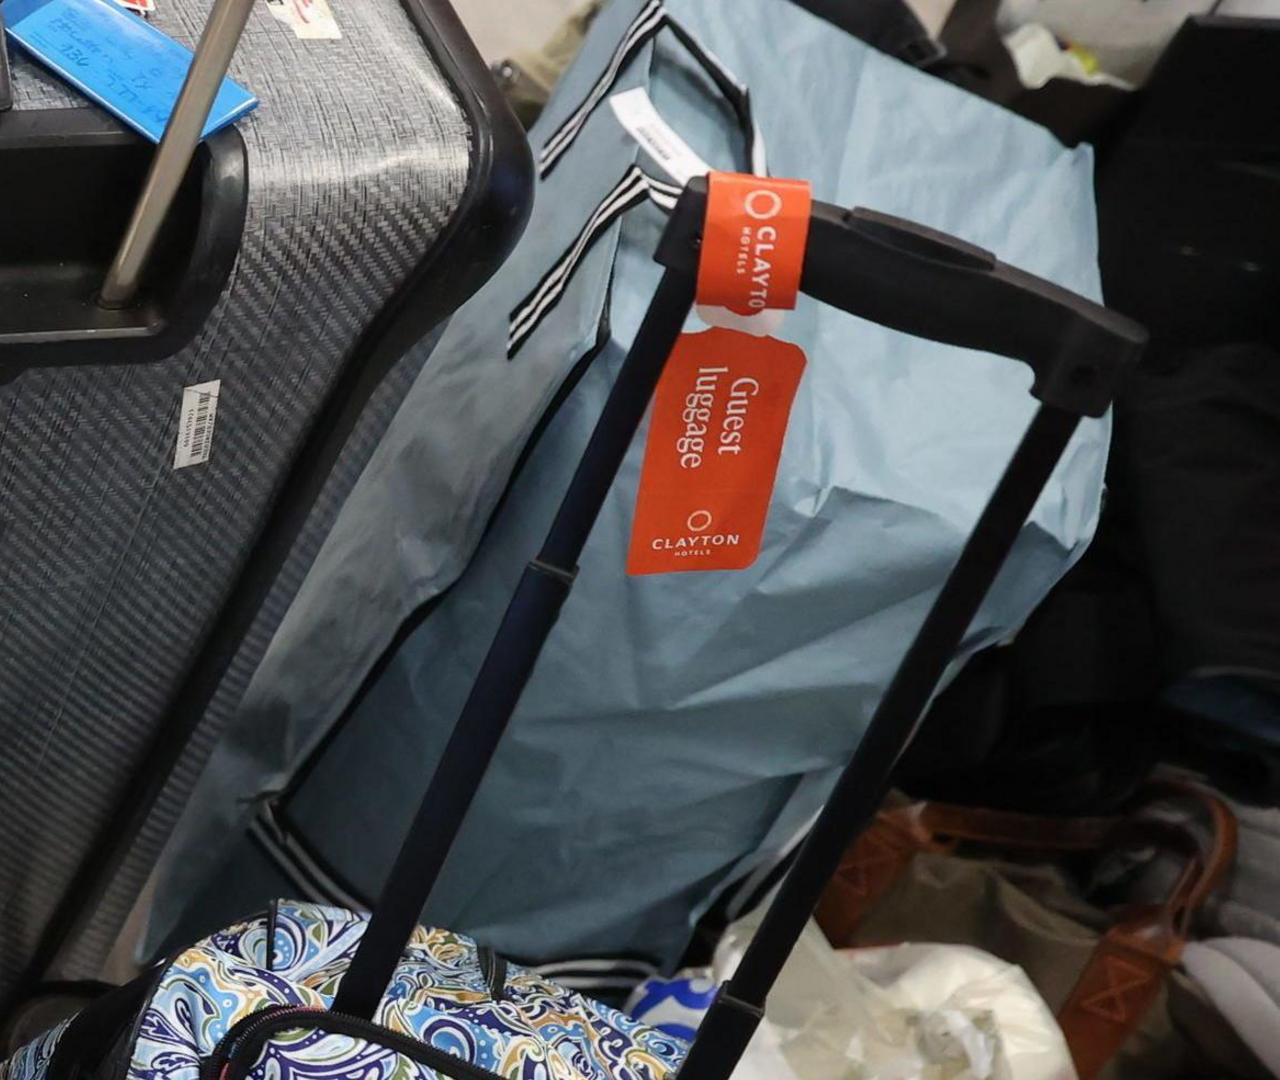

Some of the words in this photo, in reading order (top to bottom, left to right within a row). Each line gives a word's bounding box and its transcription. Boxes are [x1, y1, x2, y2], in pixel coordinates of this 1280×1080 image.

[748, 226, 777, 308] CLAYTO
[677, 367, 728, 469] luggage
[718, 377, 759, 455] Guest
[652, 534, 740, 550] CLAYTON
